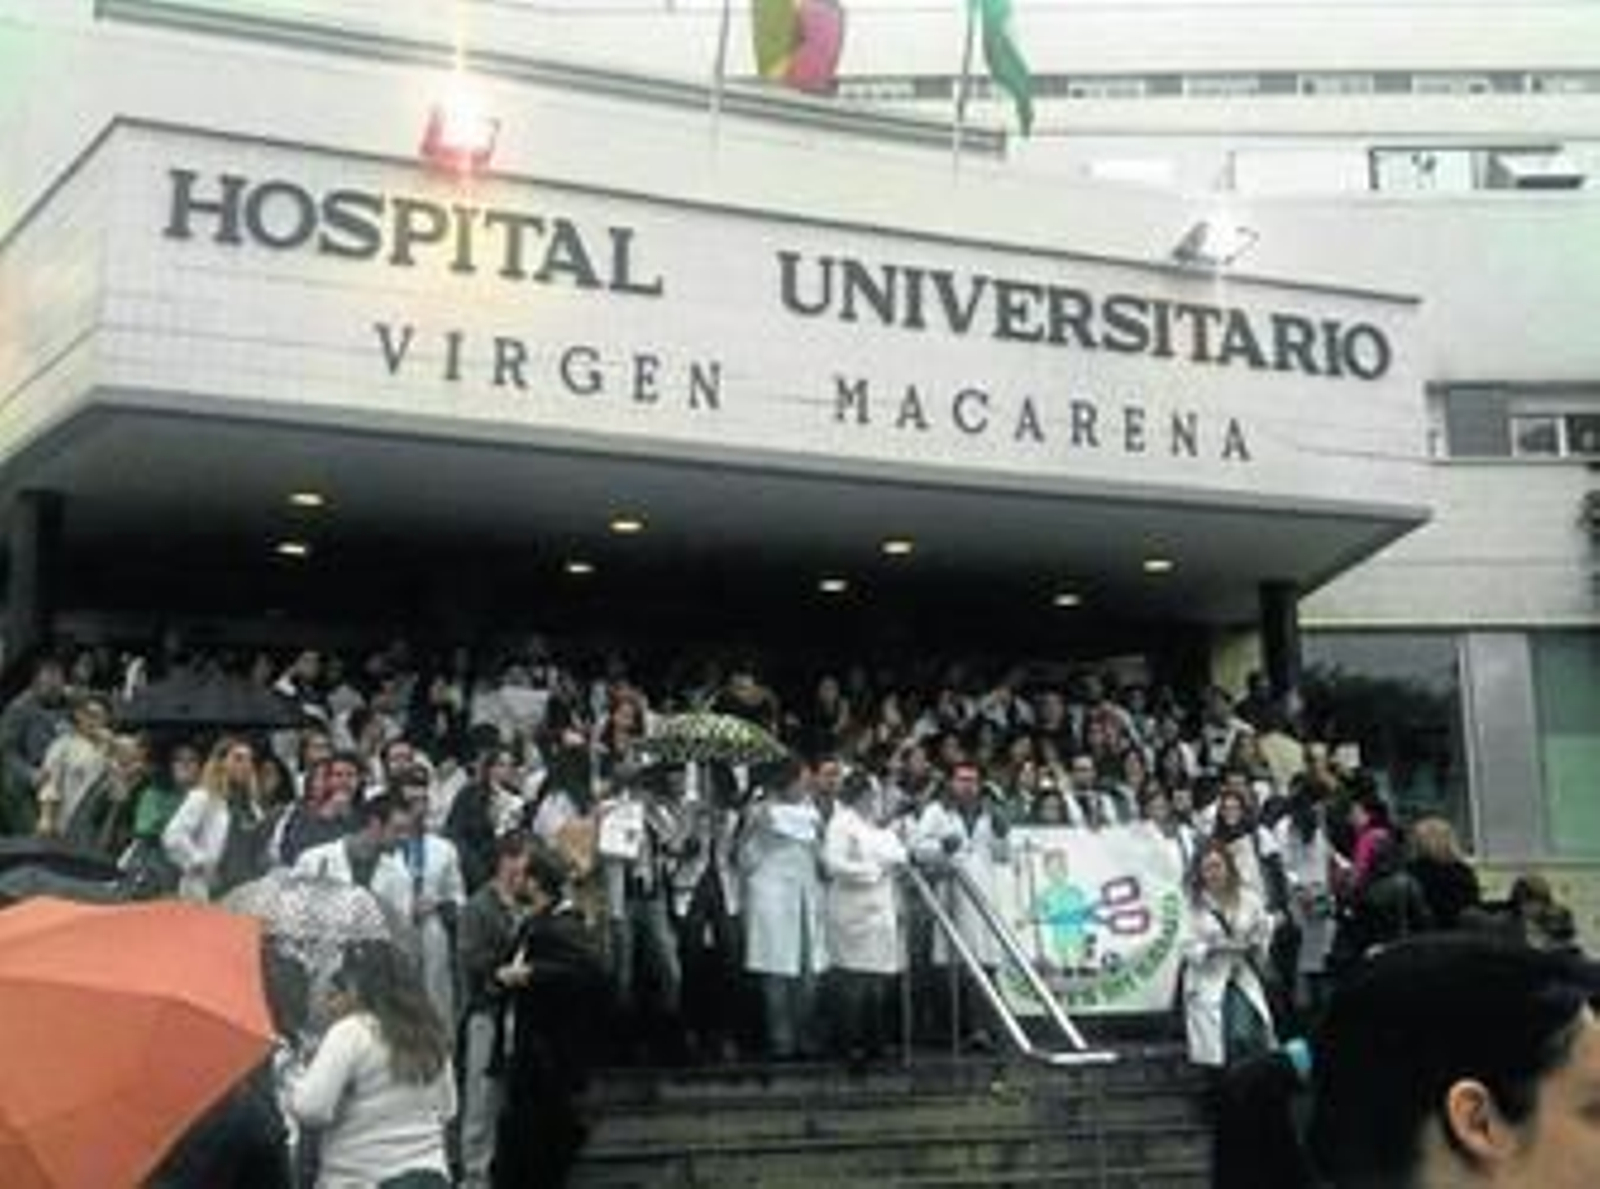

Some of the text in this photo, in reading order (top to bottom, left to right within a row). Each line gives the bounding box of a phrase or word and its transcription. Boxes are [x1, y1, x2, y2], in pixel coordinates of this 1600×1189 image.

[163, 168, 1392, 381] HOSPITAL UNIVERSITARIO
[375, 322, 1252, 461] VIRGEN MACARENA
